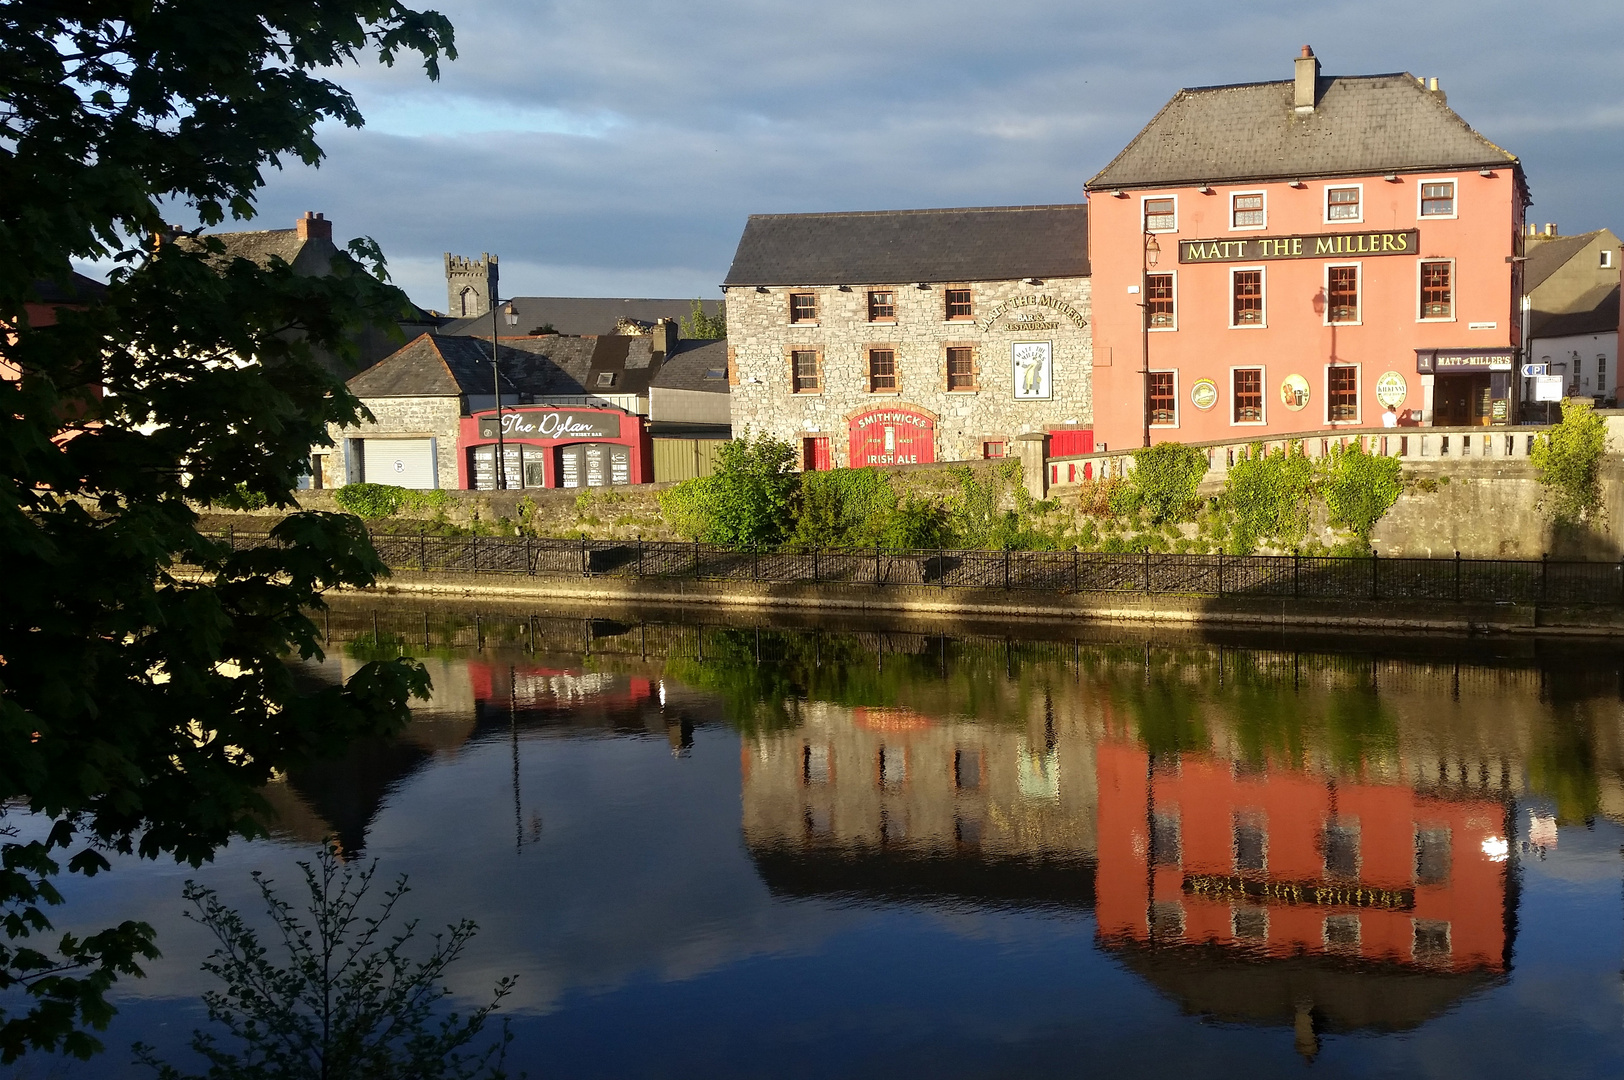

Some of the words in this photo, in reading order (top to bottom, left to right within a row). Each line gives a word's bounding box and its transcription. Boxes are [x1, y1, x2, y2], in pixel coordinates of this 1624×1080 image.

[1188, 240, 1248, 260] MATT
[1259, 238, 1303, 257] THE
[1315, 233, 1408, 254] MILLERS
[978, 302, 1009, 333] MATT
[1009, 295, 1037, 309] THE
[1038, 294, 1088, 330] MILLERS
[1017, 314, 1035, 322] BAR
[1036, 313, 1045, 322] &
[1004, 322, 1060, 331] RESTAURANT
[1437, 357, 1462, 366] MATT
[1470, 356, 1511, 366] MILLER'S
[501, 413, 536, 434] The
[538, 413, 594, 439] Dylan
[867, 455, 894, 464] IRISH
[897, 455, 917, 464] ALE
